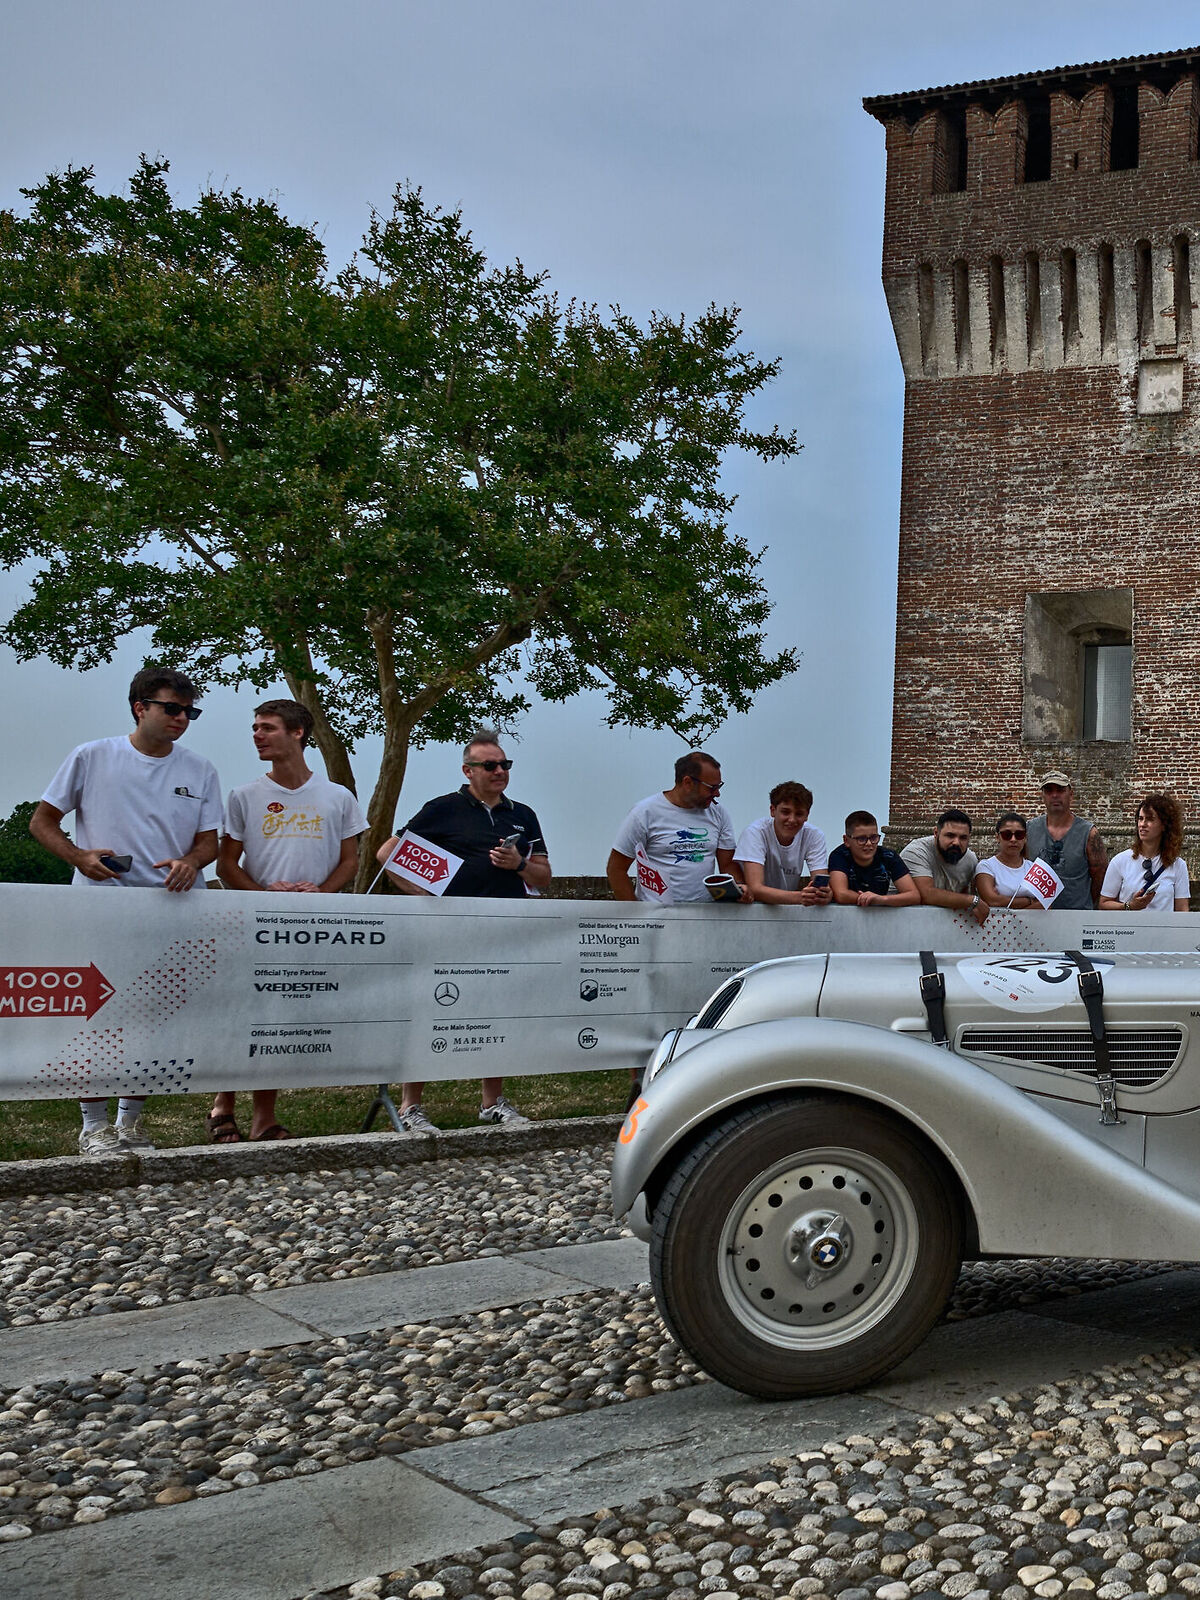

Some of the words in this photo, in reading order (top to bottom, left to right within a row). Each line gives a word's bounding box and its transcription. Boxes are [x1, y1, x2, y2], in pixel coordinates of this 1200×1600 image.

[406, 845, 440, 867] 1000
[396, 854, 435, 880] MIGLIA
[1033, 866, 1053, 886] 1000
[1026, 873, 1049, 895] MIGLIA
[256, 916, 279, 924] World
[280, 917, 309, 926] Sponsor
[317, 917, 343, 925] Official
[344, 918, 384, 927] Timekeeper
[255, 930, 386, 945] CHOPARD
[282, 969, 299, 977] Tyre
[985, 958, 1079, 983] 123
[5, 972, 82, 989] 1000
[254, 982, 339, 992] VREDESTEIN
[0, 996, 87, 1013] MIGLIA
[251, 1029, 278, 1037] Official
[279, 1029, 312, 1037] Sparkling
[466, 1023, 491, 1031] Sponsor
[453, 1036, 506, 1045] MARREYT
[260, 1043, 332, 1055] FRANCIACORTA
